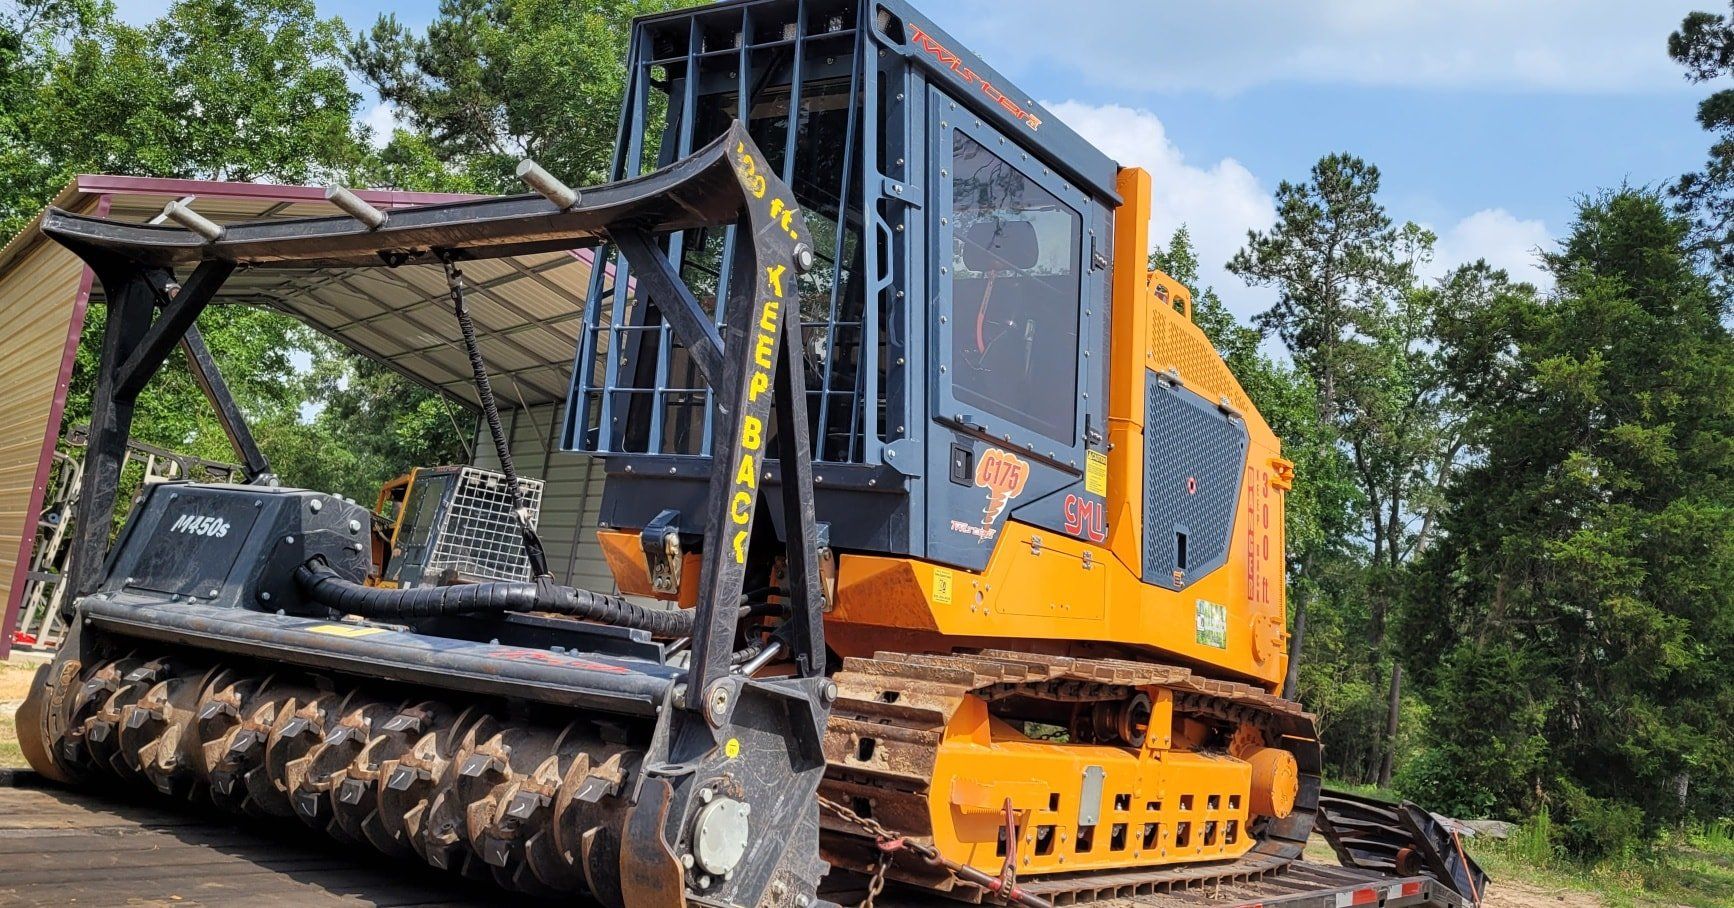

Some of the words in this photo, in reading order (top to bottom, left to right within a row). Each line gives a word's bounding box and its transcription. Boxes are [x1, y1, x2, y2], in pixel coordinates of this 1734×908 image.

[769, 198, 798, 240] ft.
[748, 264, 786, 402] KEEP
[983, 456, 1021, 490] C175
[170, 514, 231, 538] M450s
[1064, 493, 1106, 543] CMI
